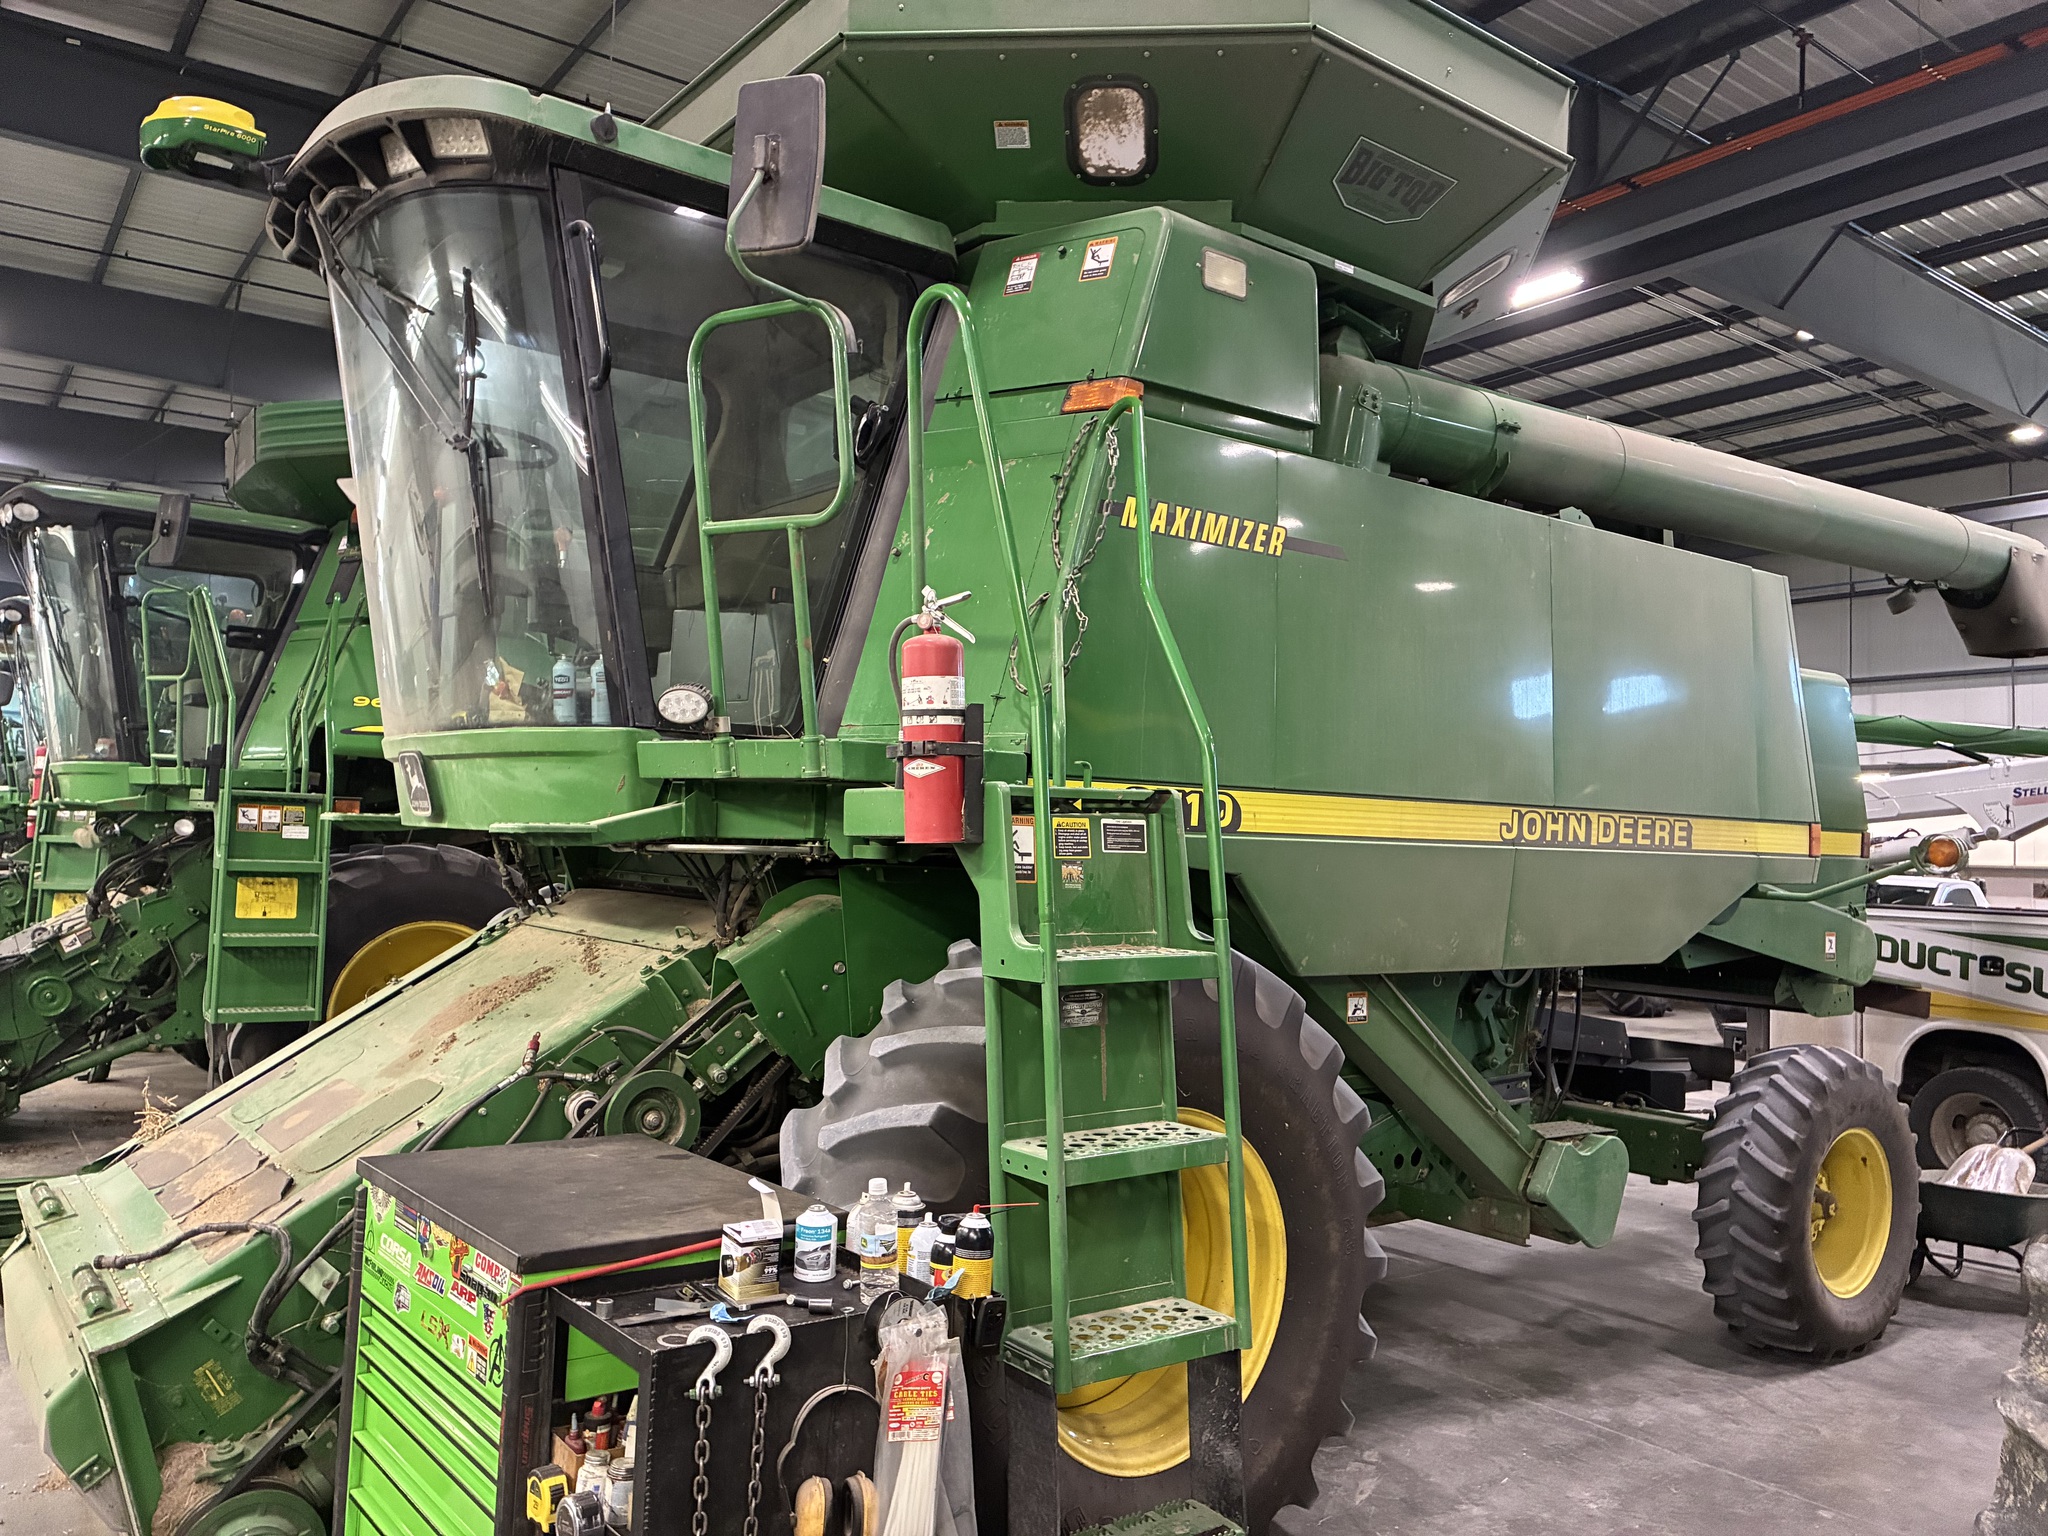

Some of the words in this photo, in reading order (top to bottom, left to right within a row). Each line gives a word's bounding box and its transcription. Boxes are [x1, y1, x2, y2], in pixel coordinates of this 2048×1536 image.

[203, 123, 235, 137] StarFire
[236, 133, 257, 143] 6000
[1340, 147, 1395, 192] BIG
[1387, 171, 1447, 215] TOP
[1120, 496, 1286, 557] MAXIMIZER
[1012, 817, 1034, 825] ARNING
[1500, 809, 1592, 845] JOHN
[1598, 814, 1693, 849] DEERE
[380, 1233, 411, 1269] CORSA
[475, 1252, 501, 1279] COMP
[414, 1261, 445, 1295] AMSOIL
[450, 1280, 477, 1304] ARP
[893, 1390, 918, 1398] CABLE
